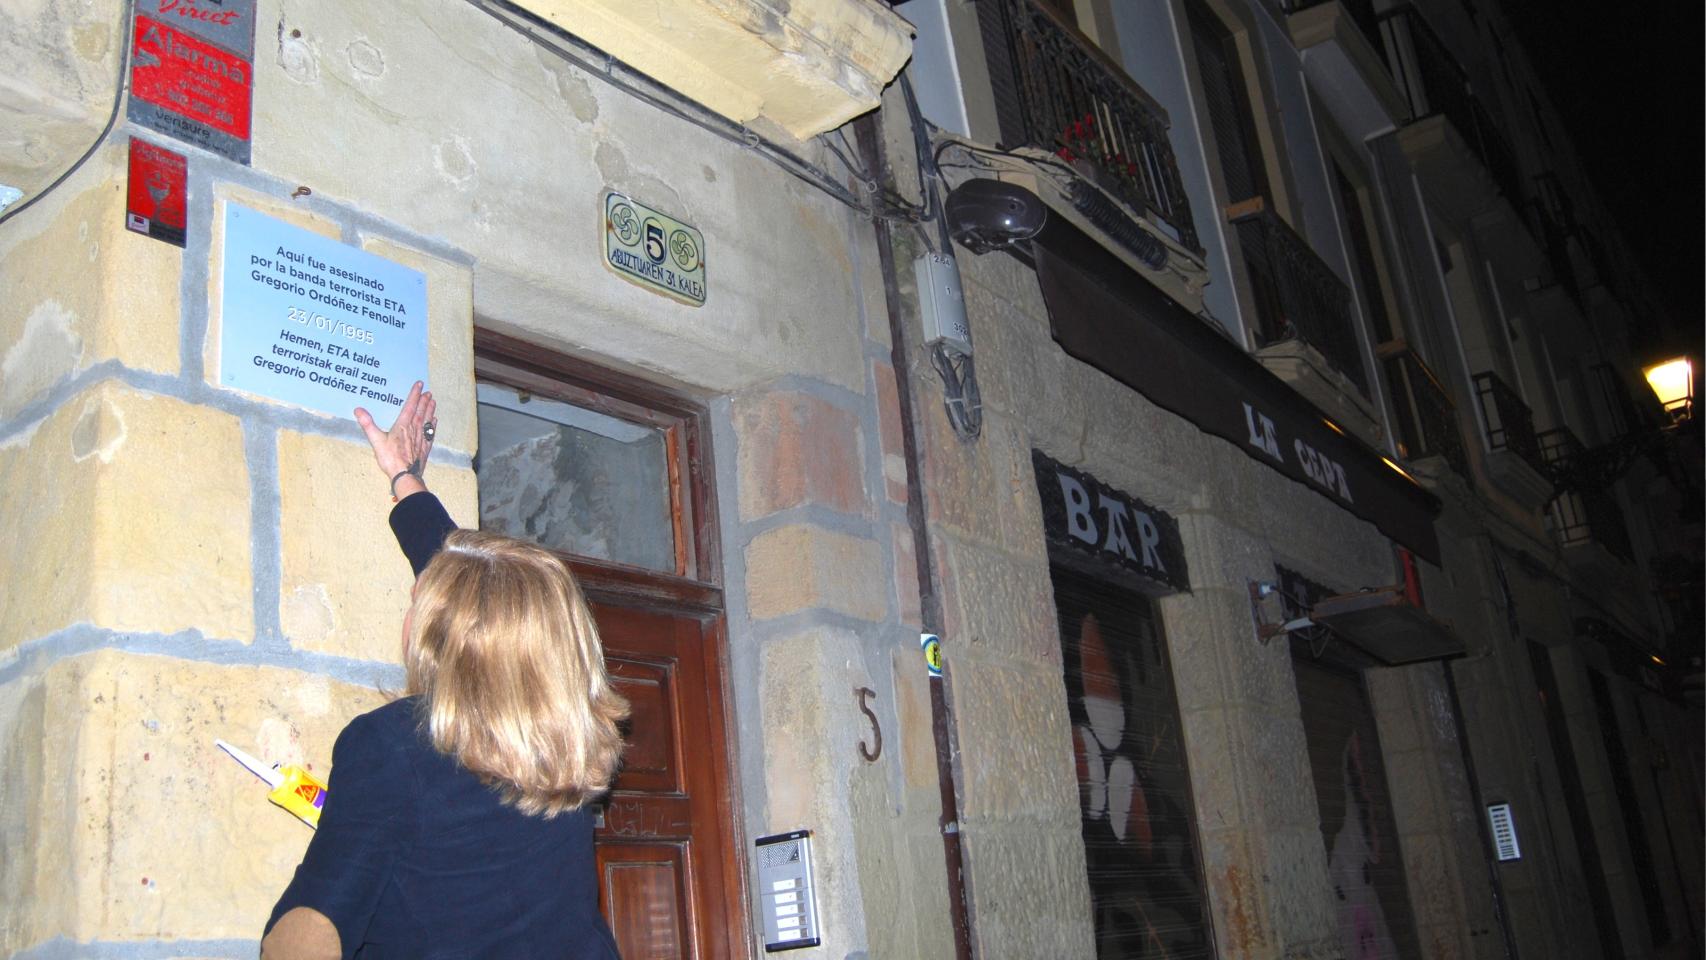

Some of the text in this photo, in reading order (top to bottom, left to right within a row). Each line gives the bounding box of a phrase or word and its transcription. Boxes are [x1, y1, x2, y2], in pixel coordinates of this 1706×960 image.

[647, 223, 665, 261] 5
[251, 255, 406, 315] por la banda terrorista ETA
[308, 256, 326, 271] fue
[329, 265, 385, 292] asesinado
[611, 248, 704, 297] ABUZTUAREN 31 KALEA
[251, 270, 406, 329] Gregorio Ordóñez Fenollar
[280, 329, 380, 368] Hemen, ETA talde
[287, 305, 374, 345] 23/01/1995
[253, 355, 404, 407] Gregorio Ordóñez Fenollar
[272, 343, 387, 386] terroristak erail zuen
[1242, 401, 1353, 504] LA CEPA
[1057, 472, 1168, 574] BAR
[859, 687, 882, 762] 5
